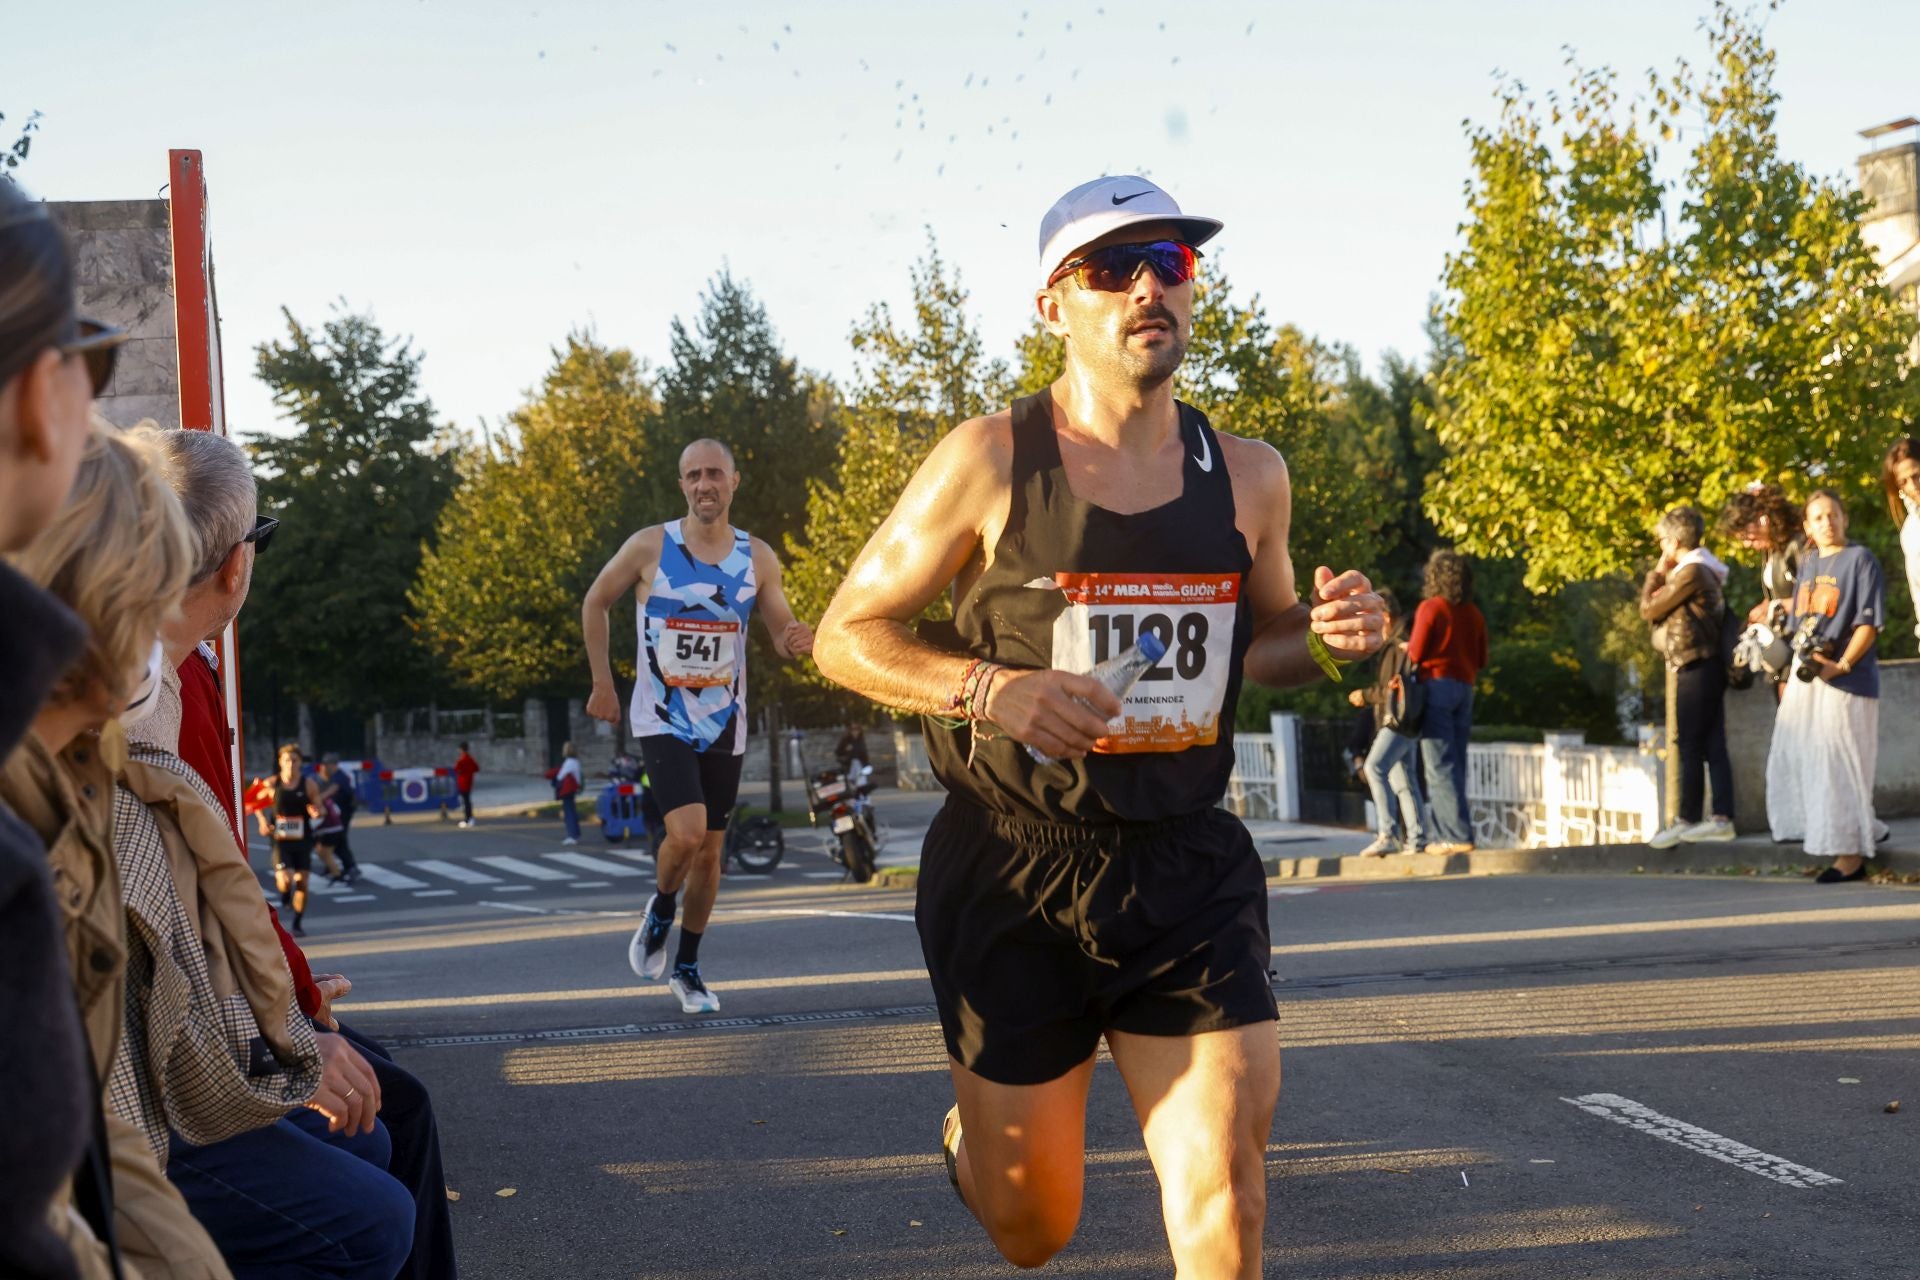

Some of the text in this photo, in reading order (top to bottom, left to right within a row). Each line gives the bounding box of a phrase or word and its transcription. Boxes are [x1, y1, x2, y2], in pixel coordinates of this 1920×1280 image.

[1113, 584, 1151, 597] MBA
[1180, 582, 1216, 597] GIJÓN
[676, 634, 721, 662] 541
[1089, 612, 1208, 682] 1128
[1134, 695, 1185, 705] MENENDEZ
